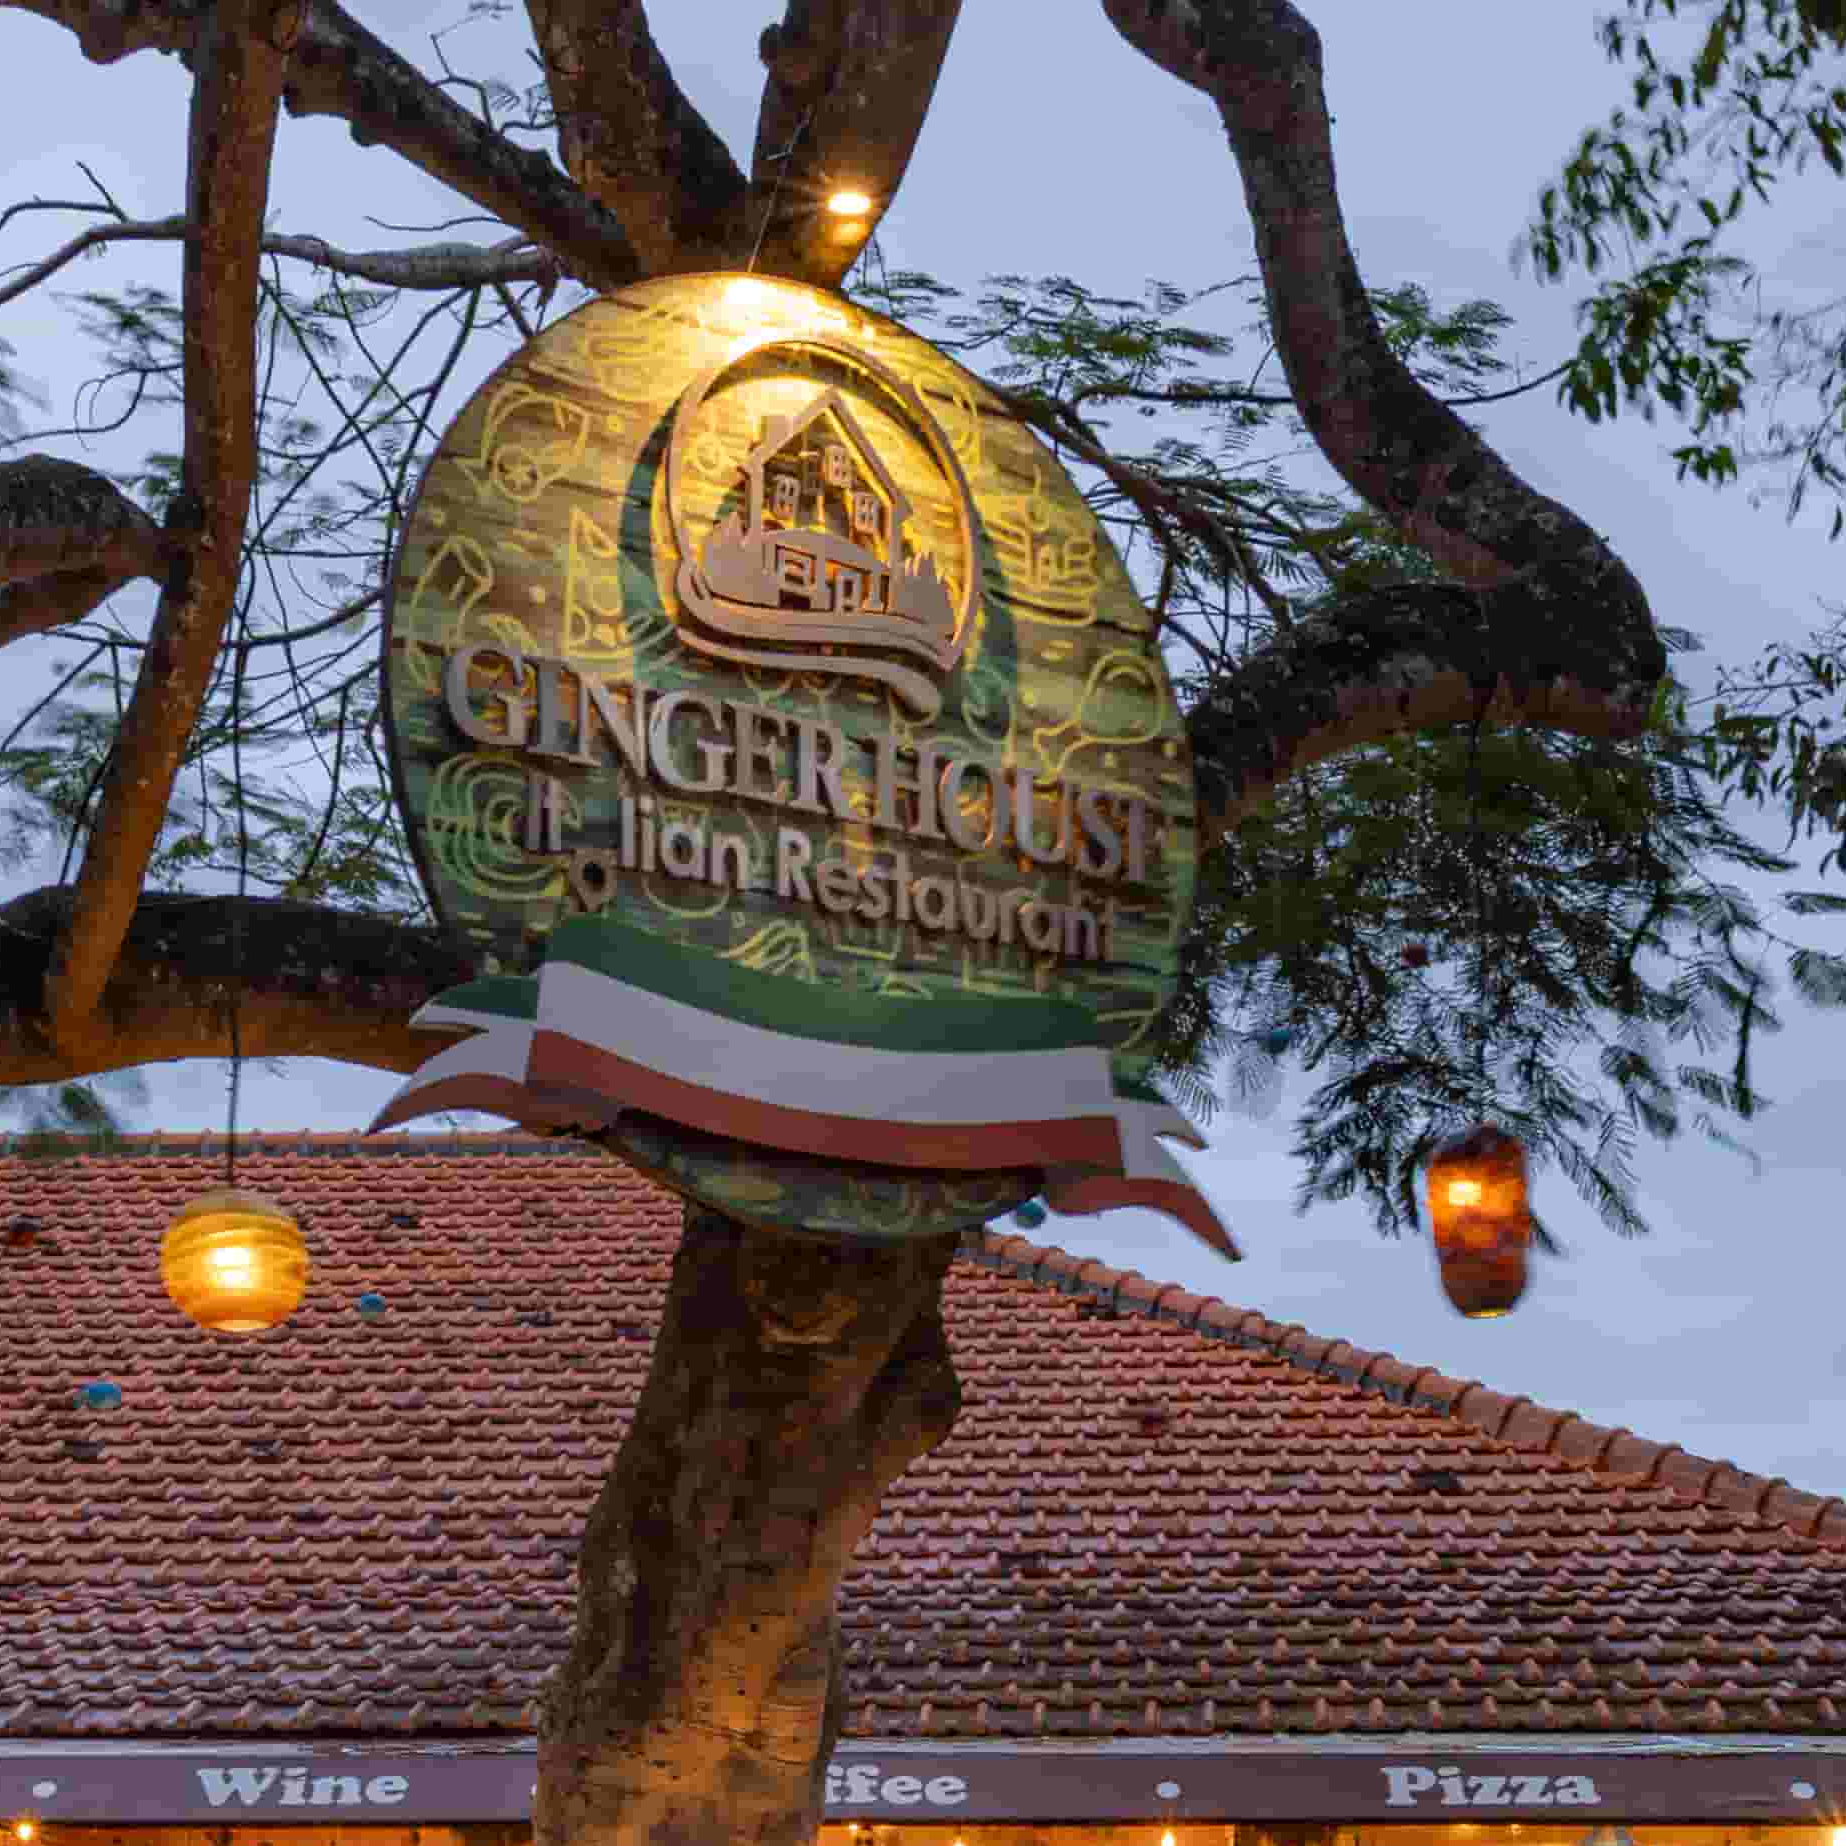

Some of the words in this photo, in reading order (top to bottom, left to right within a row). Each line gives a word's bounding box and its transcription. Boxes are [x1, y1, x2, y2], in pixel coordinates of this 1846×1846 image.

[446, 645, 863, 814] GINGER
[524, 769, 747, 892] Itlian
[776, 825, 1116, 960] Restaurant
[195, 1766, 411, 1807] Wine
[1379, 1766, 1602, 1807] Pizza
